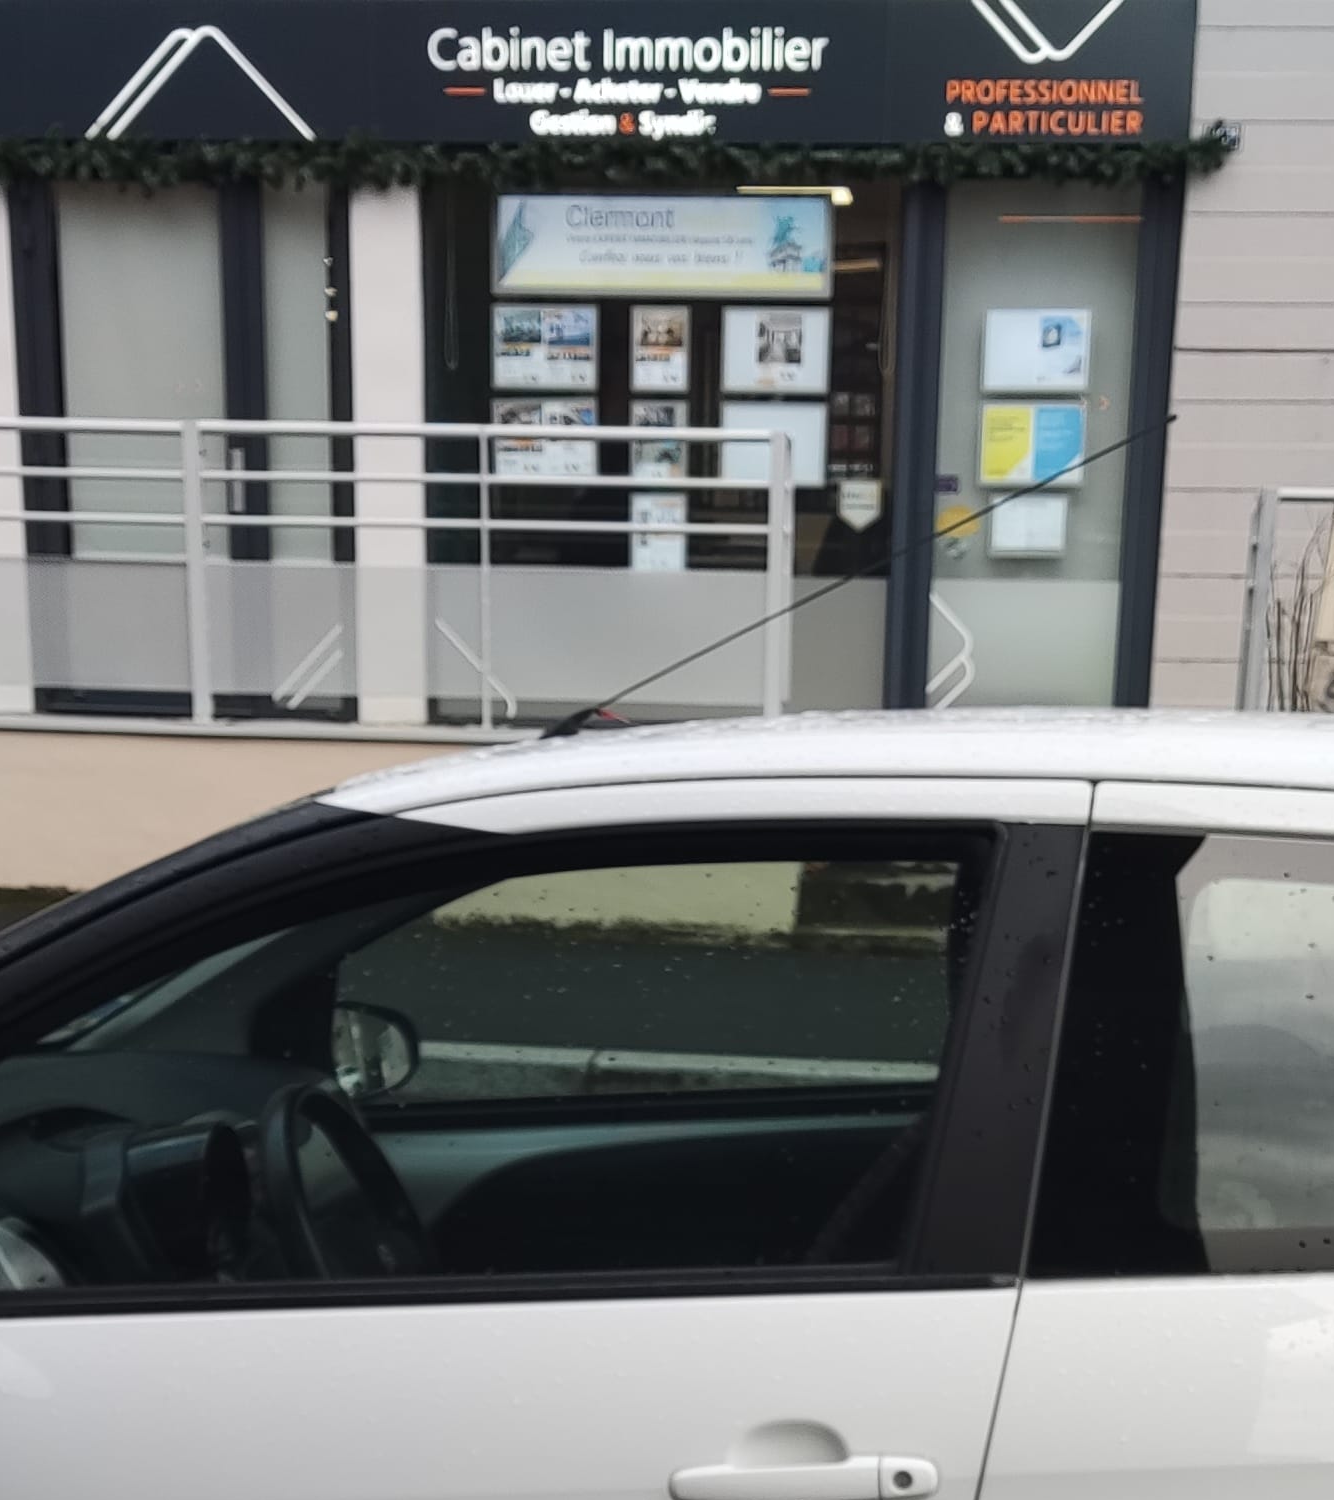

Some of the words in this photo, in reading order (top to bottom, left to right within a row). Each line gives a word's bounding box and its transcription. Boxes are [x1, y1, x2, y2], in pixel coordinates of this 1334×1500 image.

[427, 27, 591, 72] Cabinet
[603, 26, 829, 73] Immobilier
[493, 77, 559, 104] Louer
[573, 77, 664, 104] Acheter
[678, 77, 762, 104] Vendre
[945, 79, 1144, 104] PROFESSIONNEL
[529, 108, 616, 136] Gestion
[619, 112, 636, 135] &
[944, 111, 964, 137] &
[971, 110, 1144, 135] PARTICULIER
[566, 204, 675, 228] Clermont
